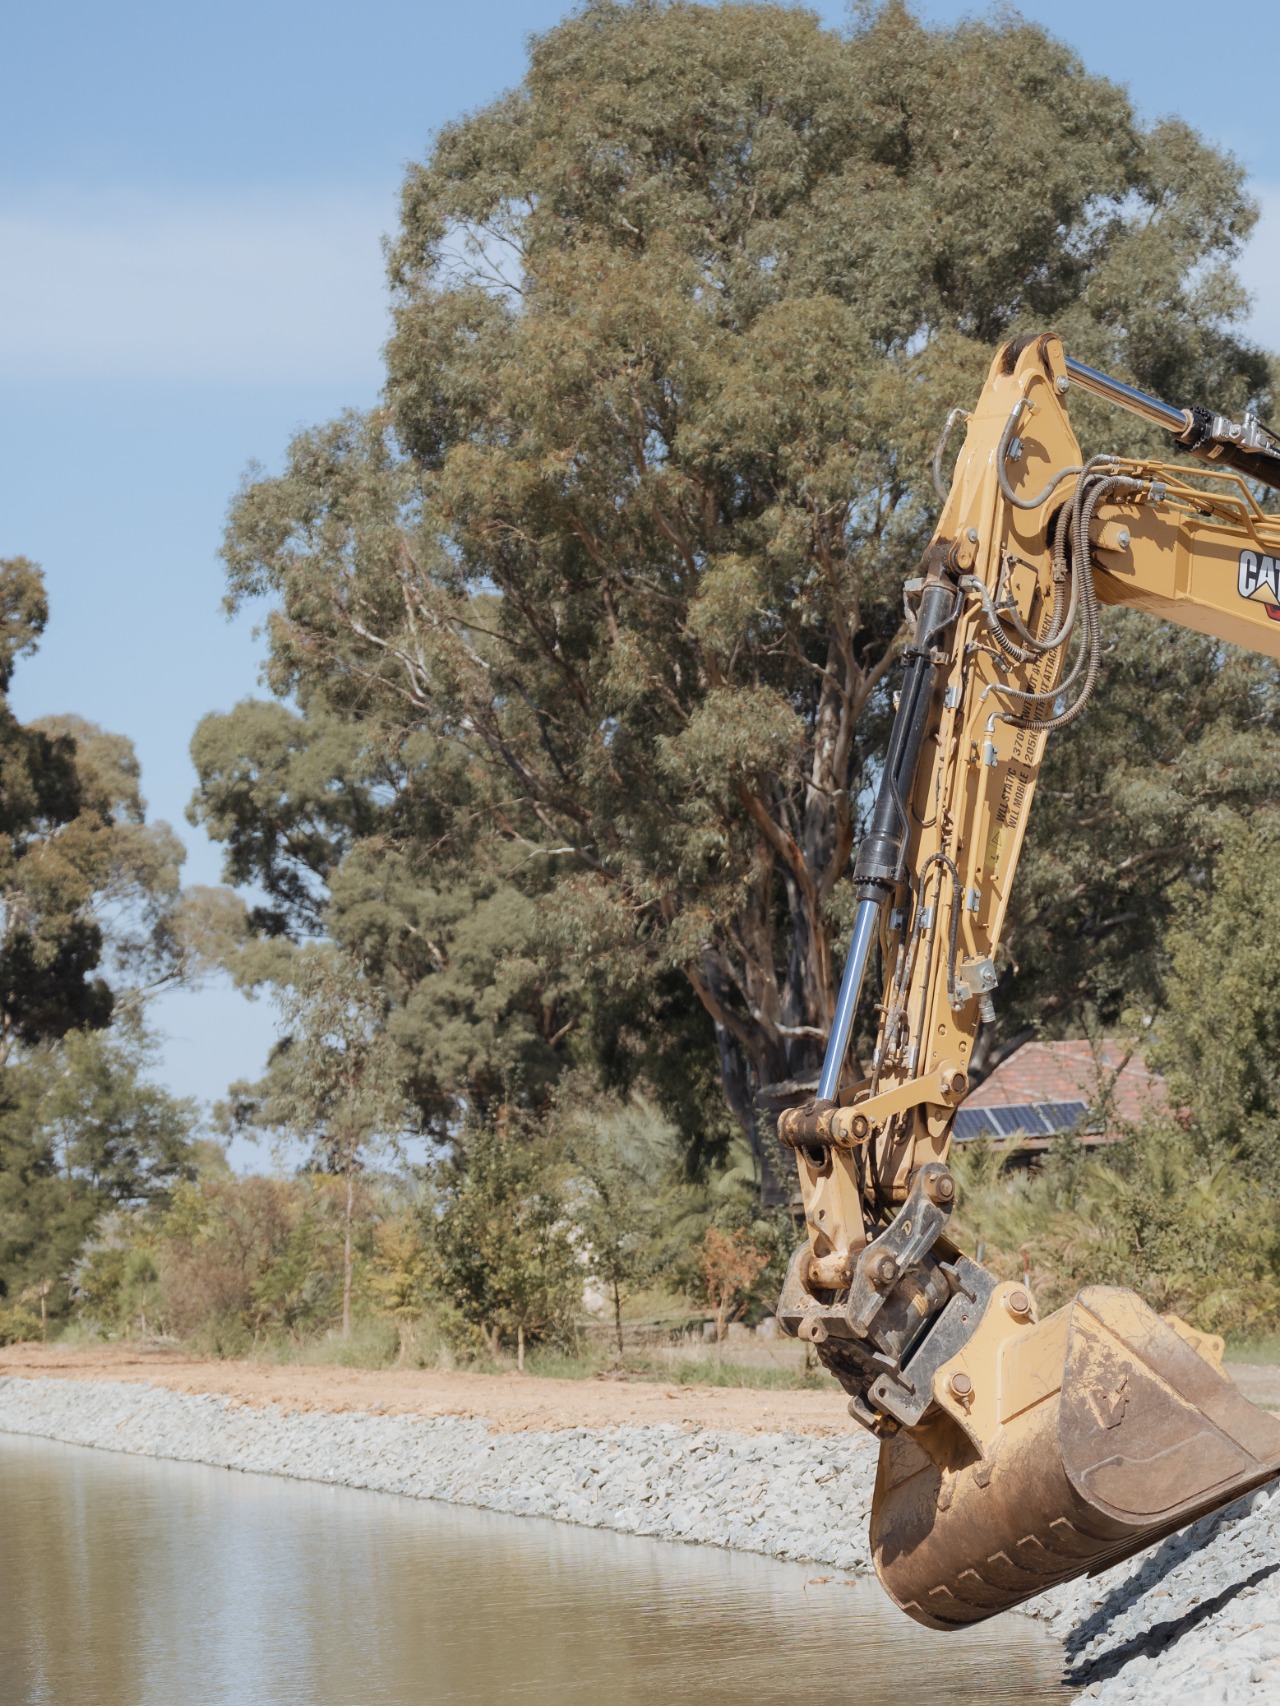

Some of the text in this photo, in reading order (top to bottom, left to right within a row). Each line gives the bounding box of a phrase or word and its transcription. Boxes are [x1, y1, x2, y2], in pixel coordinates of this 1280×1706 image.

[996, 612, 1053, 823] WLL STATIC 1370K WITOUT ATTMENT
[1034, 681, 1050, 720] WITHUT
[1013, 771, 1029, 809] MOBILE
[1008, 810, 1020, 829] WLL
